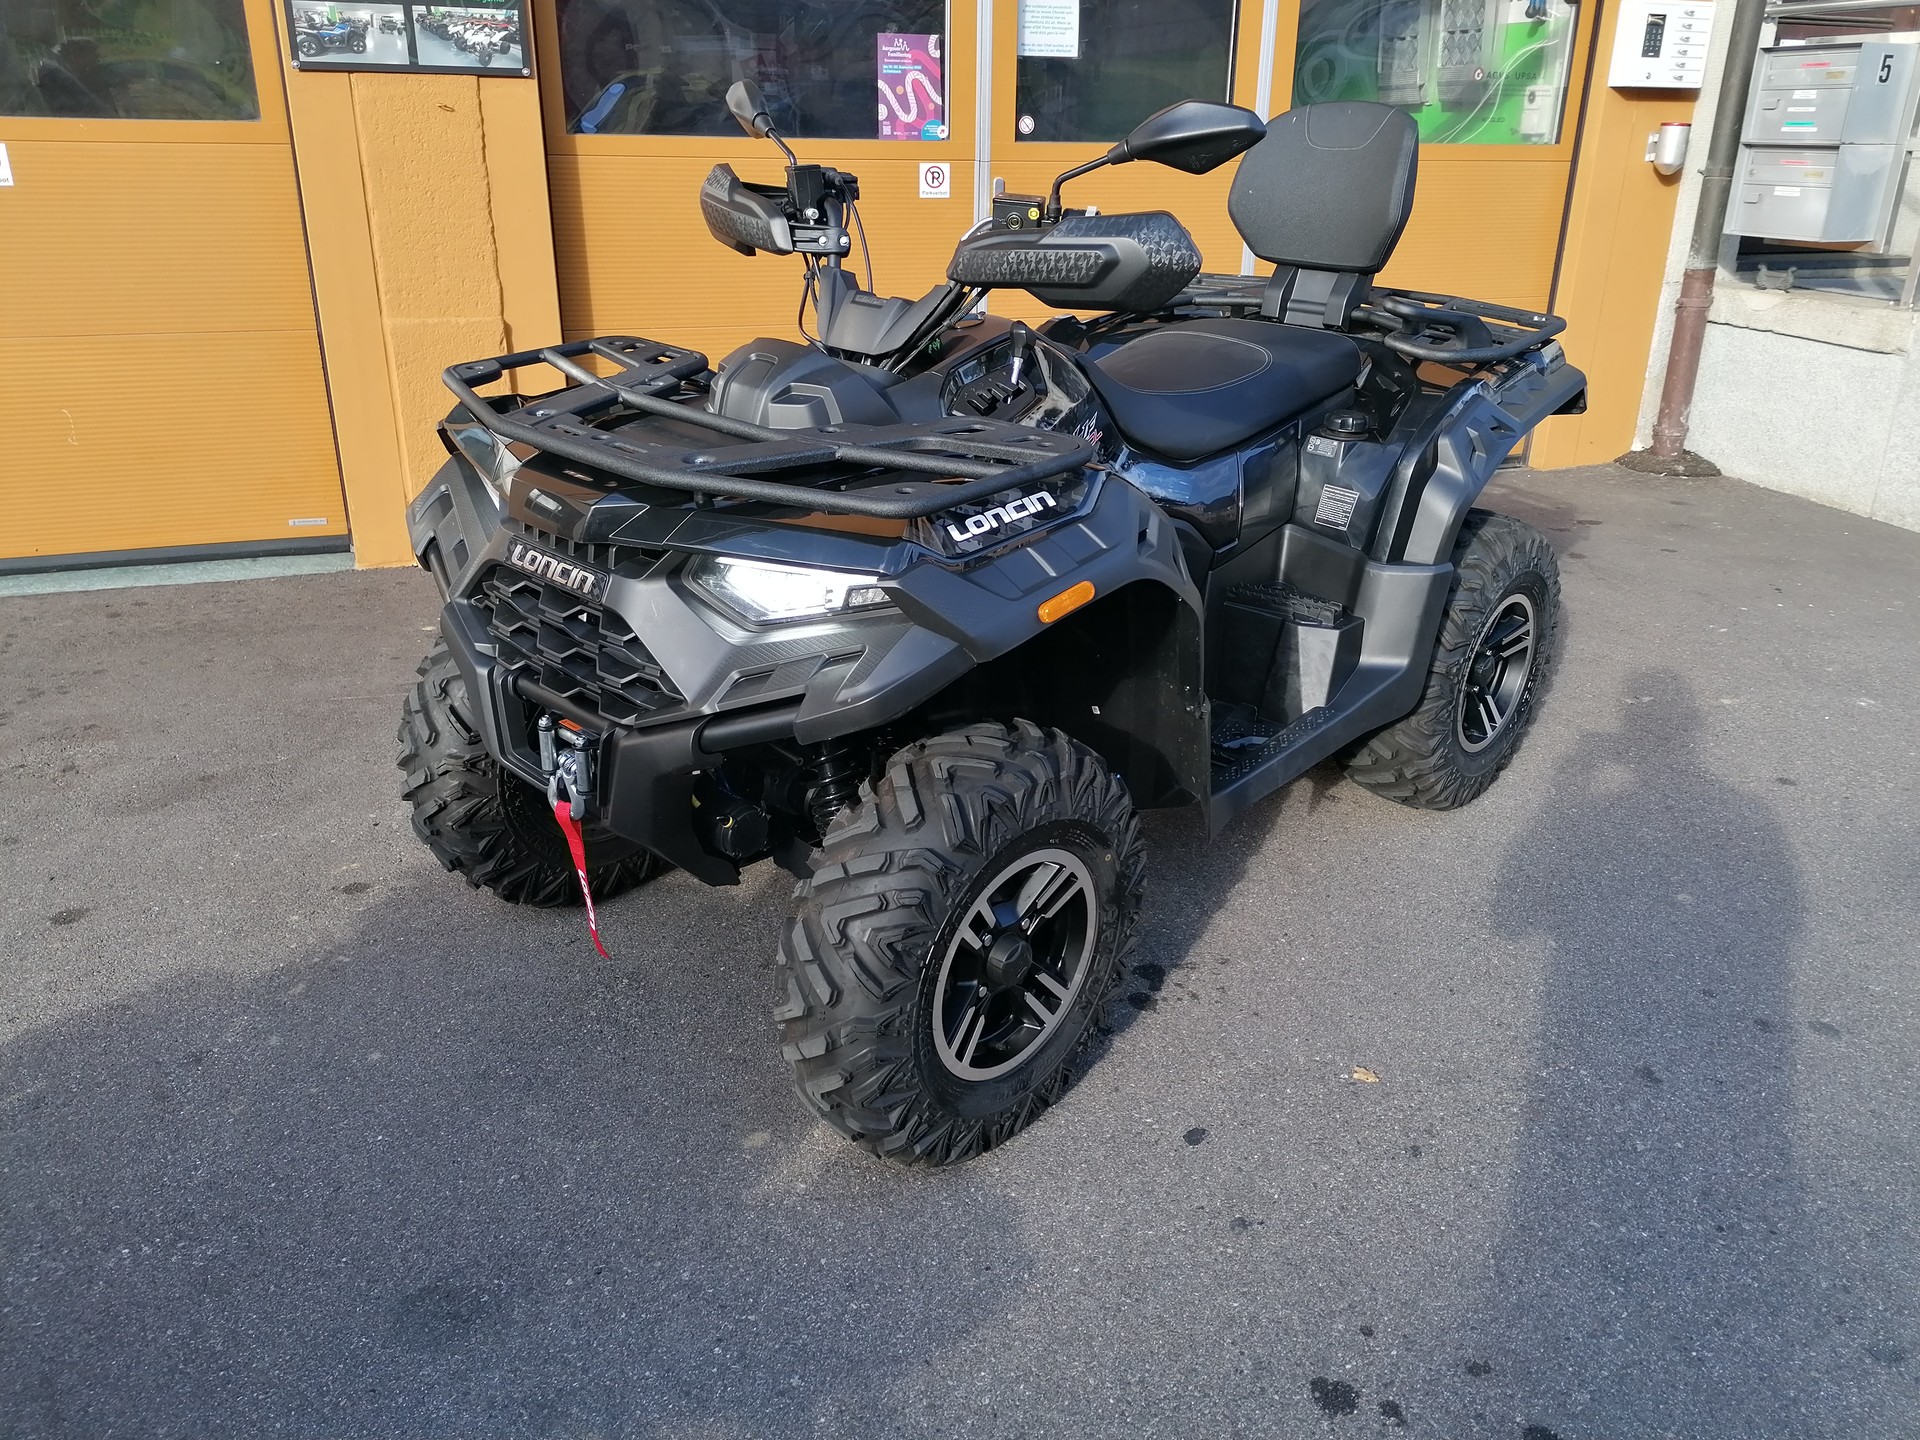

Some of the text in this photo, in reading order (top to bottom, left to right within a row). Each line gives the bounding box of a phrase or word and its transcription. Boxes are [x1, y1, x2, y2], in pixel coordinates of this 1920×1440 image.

[1515, 72, 1538, 80] UPSA
[1878, 54, 1895, 84] 5
[946, 490, 1057, 543] LONCIN
[511, 544, 596, 594] LONCIN
